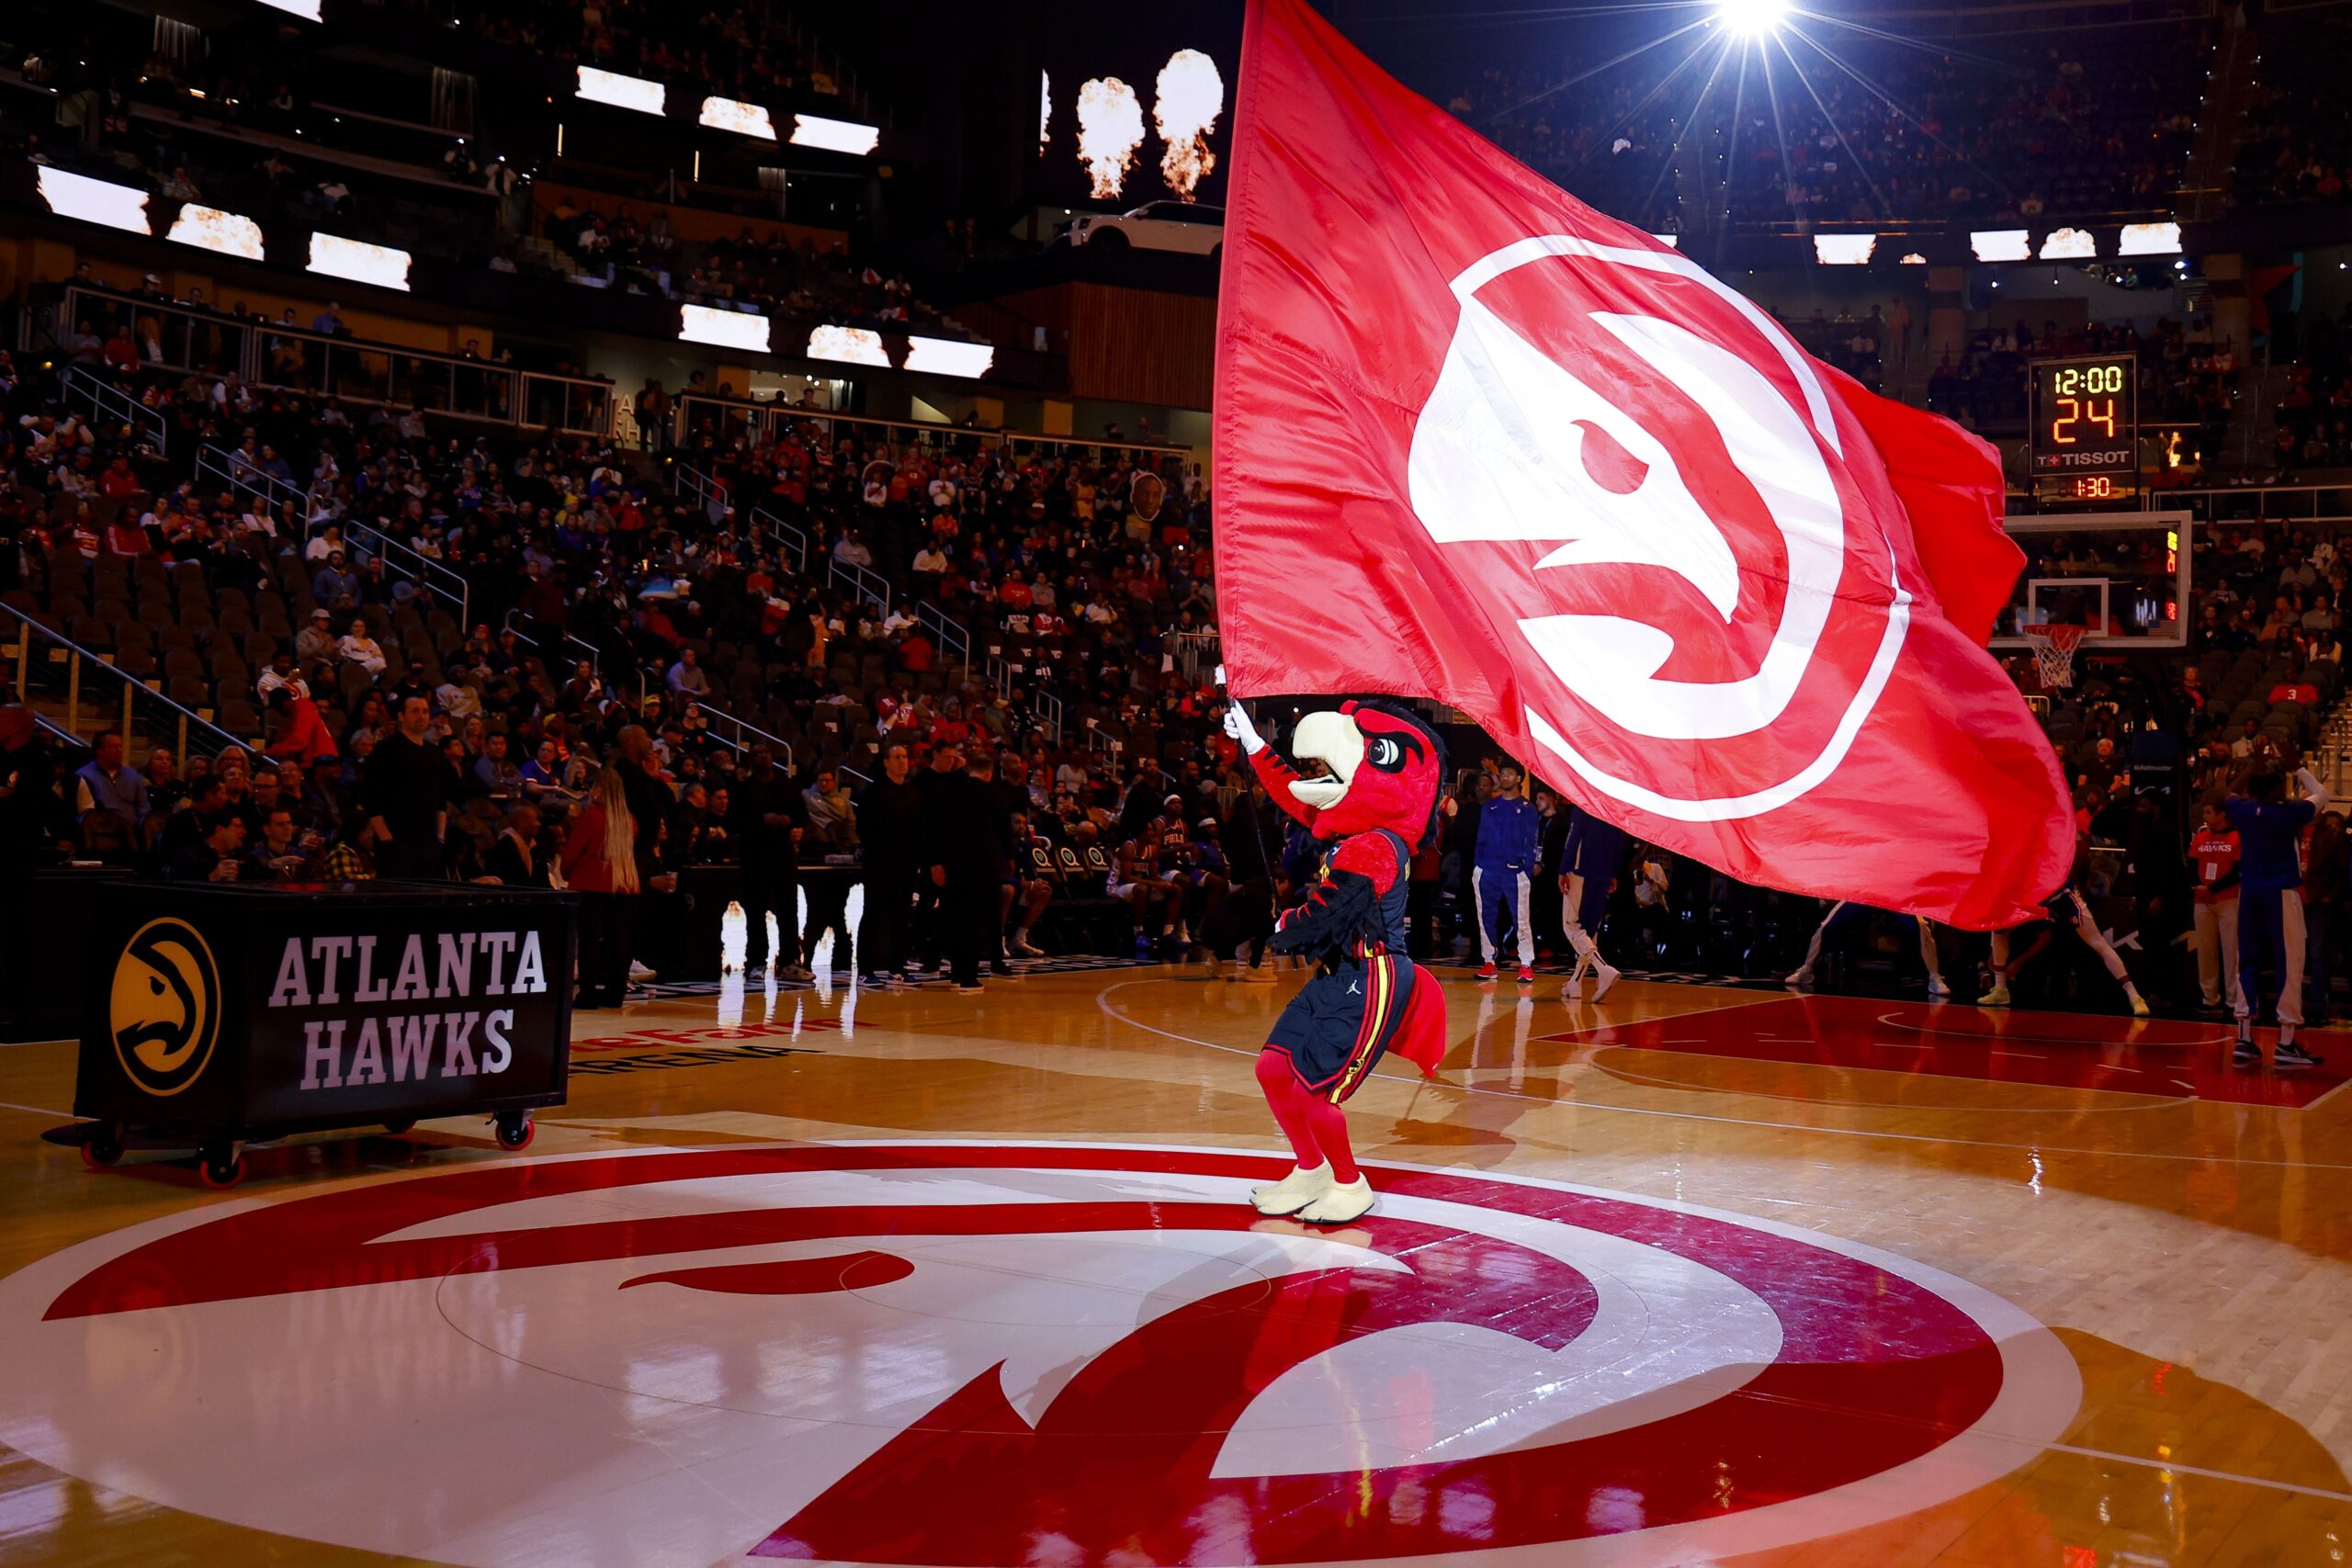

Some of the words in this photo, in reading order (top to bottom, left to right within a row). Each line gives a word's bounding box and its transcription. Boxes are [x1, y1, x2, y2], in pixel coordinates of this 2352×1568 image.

[2054, 366, 2122, 395] 12:00
[2053, 398, 2114, 444] 24
[2061, 450, 2130, 466] TISSOT
[2077, 477, 2110, 497] 1:30
[2198, 844, 2233, 852] HAWKS
[267, 931, 548, 1008] ATLANTA
[300, 1009, 514, 1090] HAWKS
